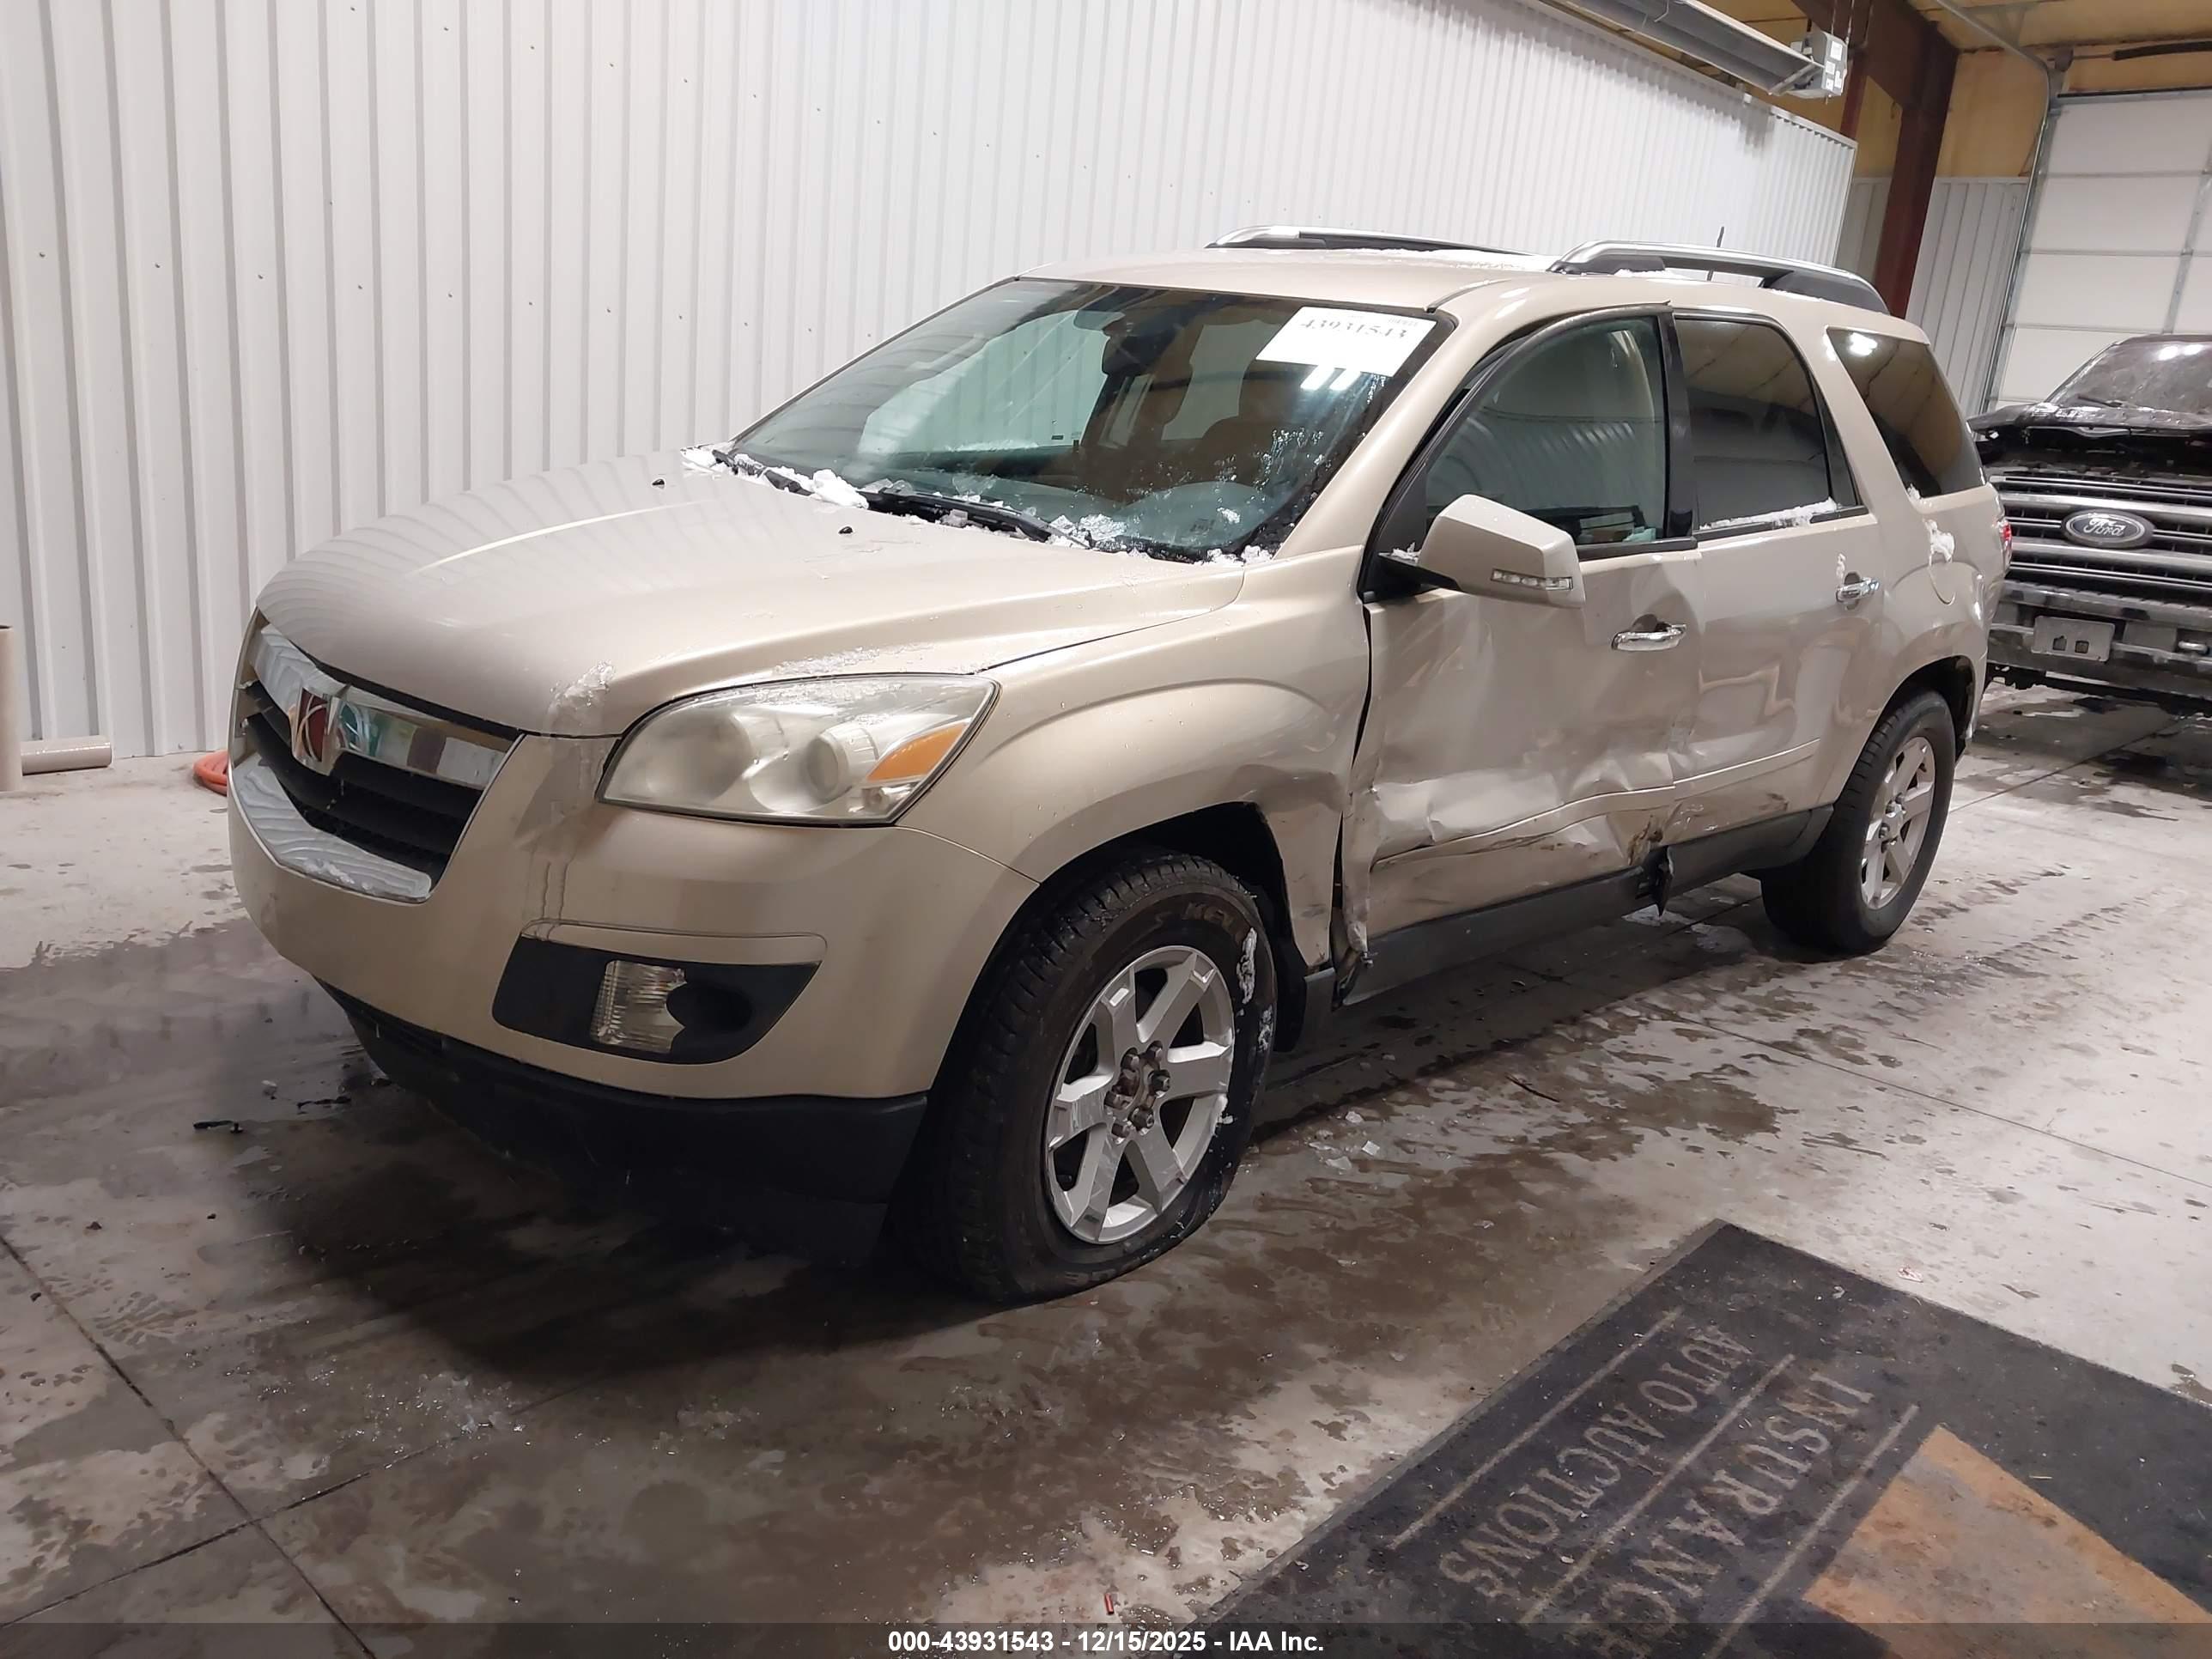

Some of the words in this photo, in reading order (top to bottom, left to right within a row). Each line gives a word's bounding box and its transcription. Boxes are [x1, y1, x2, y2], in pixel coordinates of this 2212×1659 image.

[2083, 518, 2126, 537] Ford
[1638, 1327, 1752, 1413] AUTO
[1439, 1406, 1665, 1598] AUCTIONS
